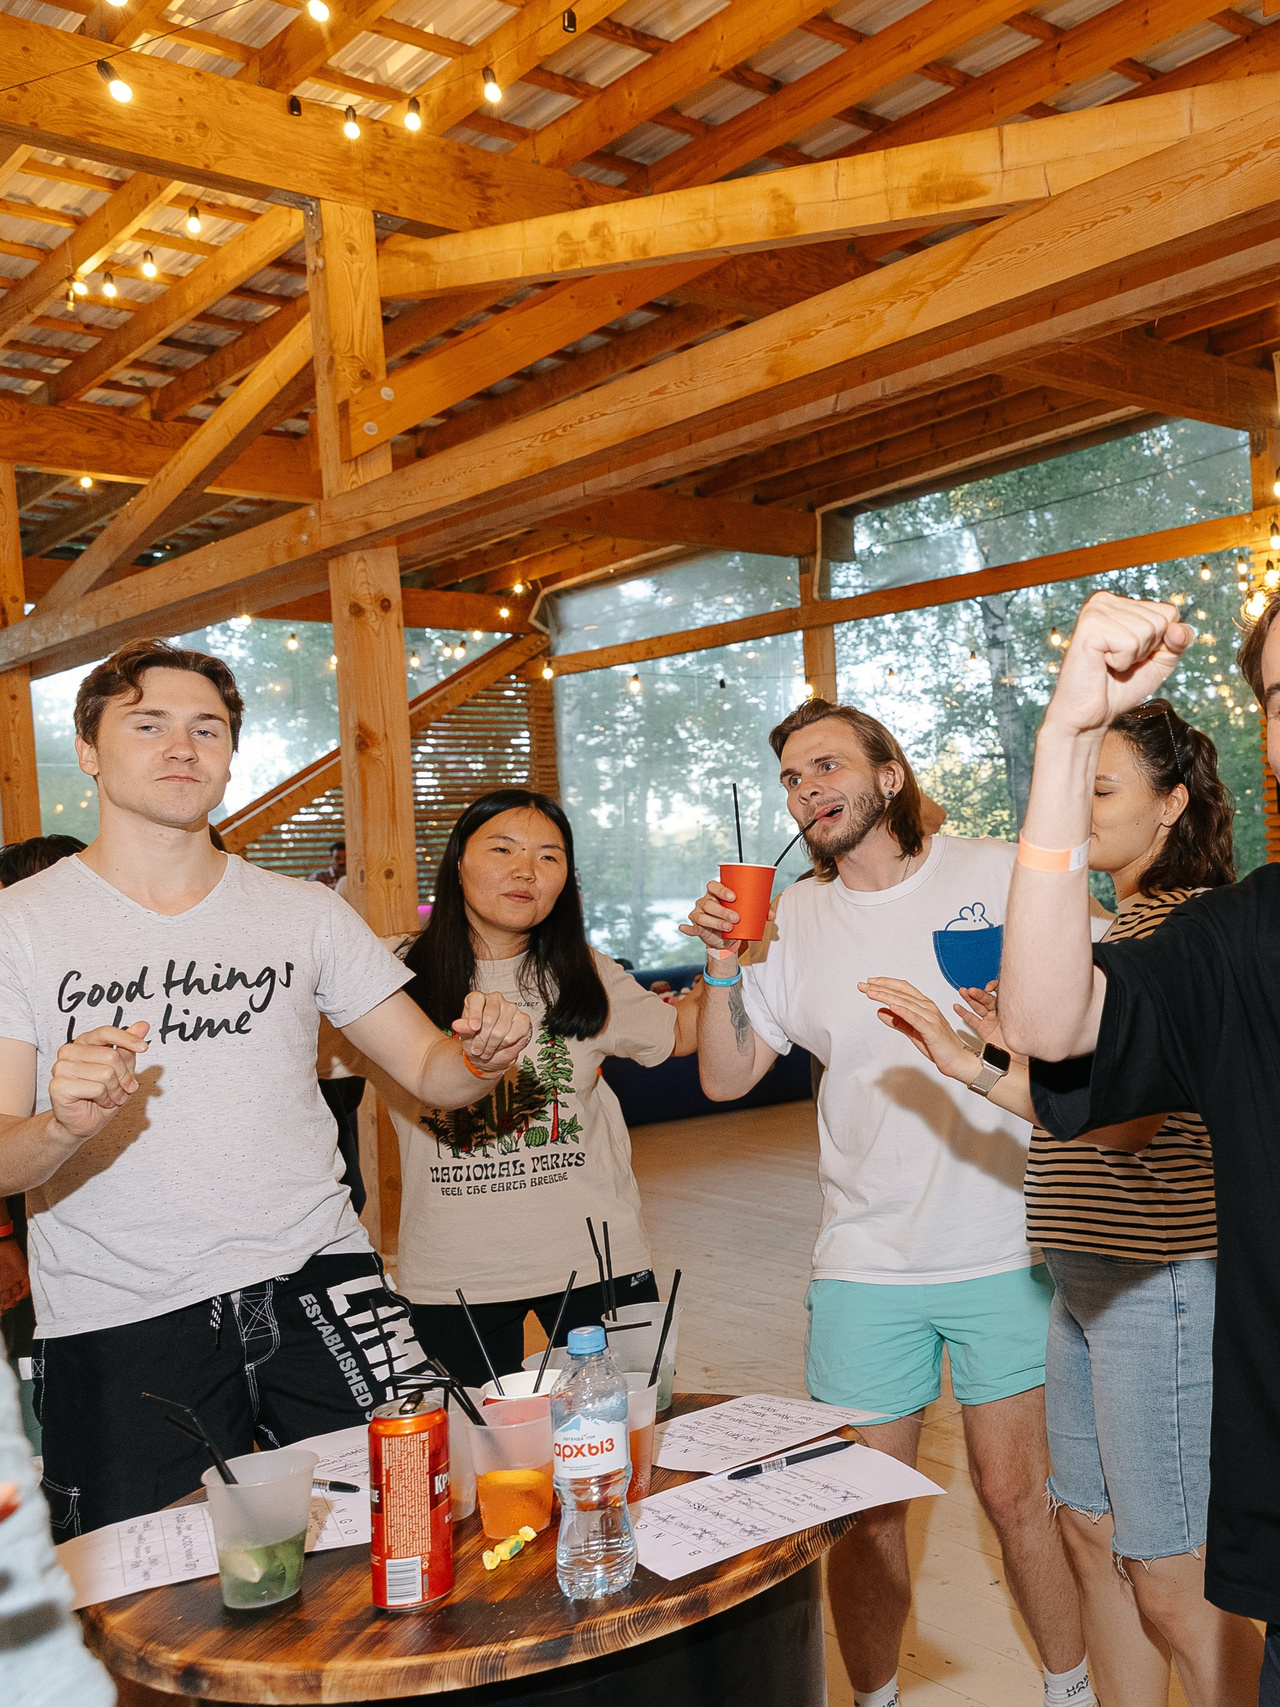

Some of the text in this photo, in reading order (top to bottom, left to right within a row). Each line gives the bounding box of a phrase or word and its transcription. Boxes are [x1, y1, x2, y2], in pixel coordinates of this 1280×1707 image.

[57, 959, 294, 1013] Good things
[158, 1003, 252, 1045] time
[430, 1152, 586, 1183] NATIONAL PARKS
[441, 1172, 569, 1196] FEEL THE EARTH BREATHE
[298, 1293, 374, 1407] ESTABLISHED
[553, 1437, 615, 1462] архыз
